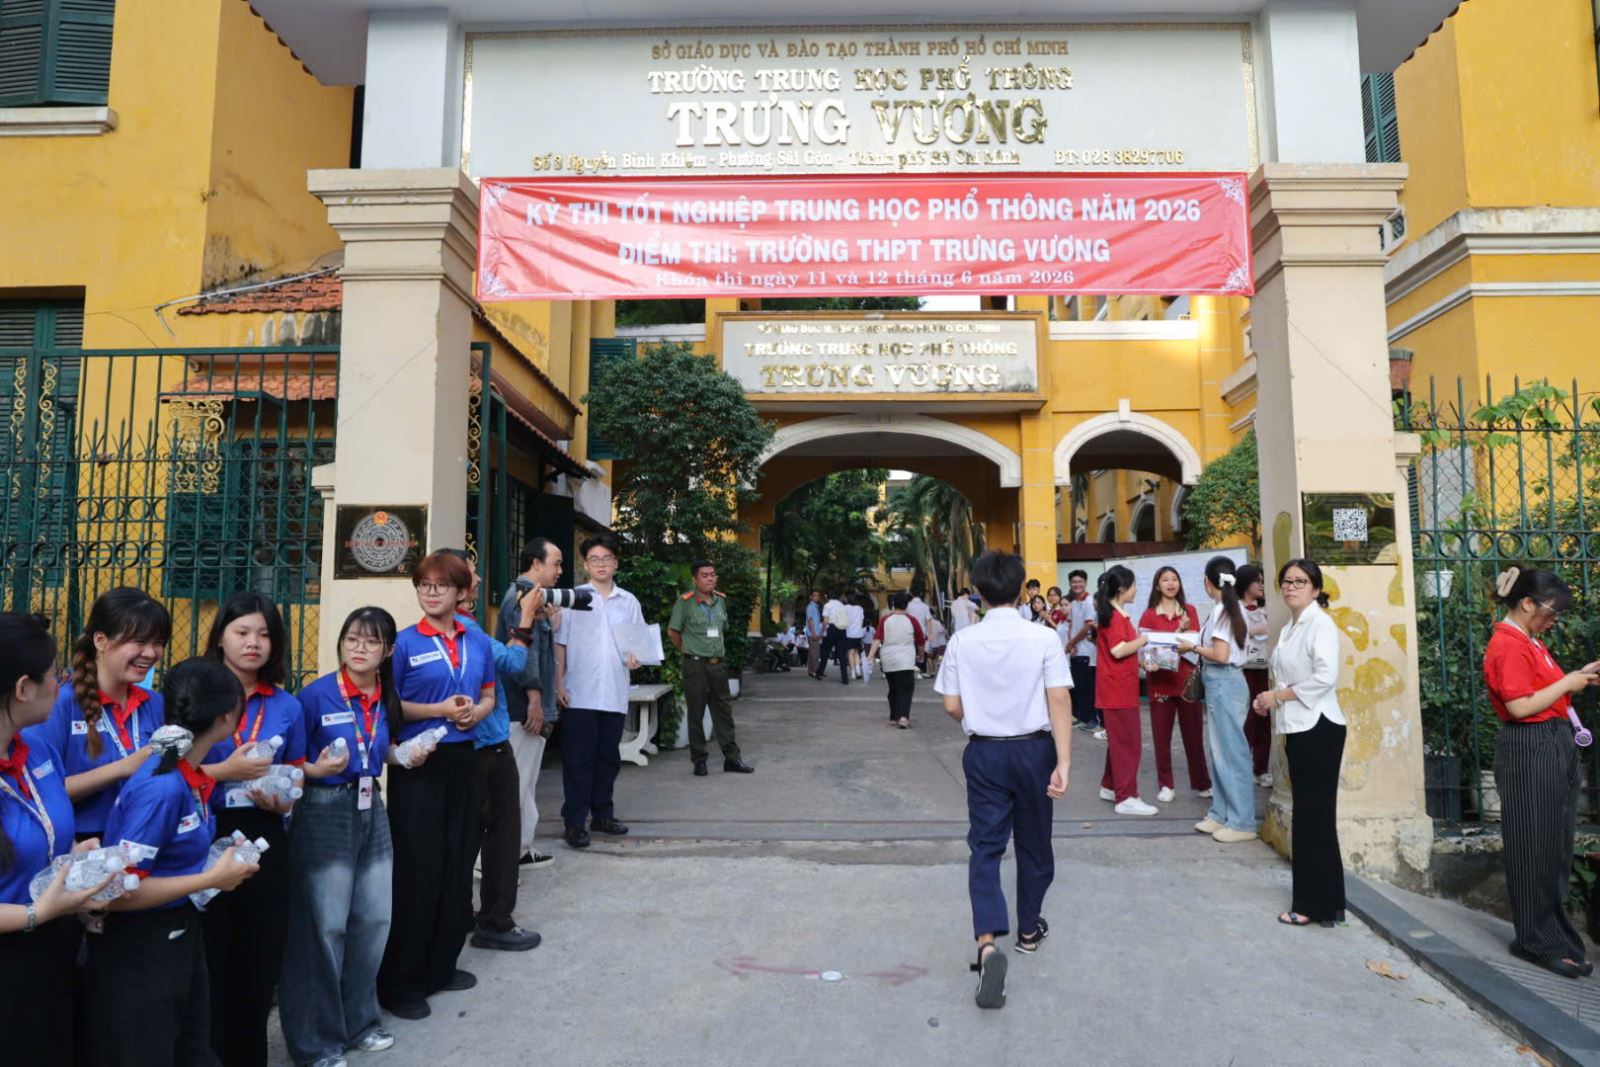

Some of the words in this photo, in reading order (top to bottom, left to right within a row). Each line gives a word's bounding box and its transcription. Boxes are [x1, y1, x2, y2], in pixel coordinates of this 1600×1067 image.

[651, 40, 671, 60] SỞ
[675, 40, 714, 59] GIÁO
[719, 43, 750, 62] DỤC
[757, 40, 779, 58] VÀ
[787, 38, 819, 58] ĐÀO
[826, 42, 858, 61] TẠO
[864, 38, 921, 56] THÀNH
[927, 37, 959, 56] PHỐ
[965, 34, 986, 55] HỒ
[993, 36, 1021, 55] CHÍ
[1027, 40, 1068, 55] MINH
[647, 64, 746, 94] TRƯỜNG
[754, 68, 842, 92] TRUNG
[854, 67, 908, 97] HỌC
[919, 55, 972, 91] PHỔ
[985, 62, 1073, 91] THÔNG
[667, 93, 851, 147] TRƯNG
[871, 91, 1048, 146] VƯƠNG
[1082, 150, 1110, 165] 028
[1113, 149, 1185, 165] 38297706
[569, 202, 609, 225] THI
[616, 192, 664, 224] TỐT
[672, 195, 768, 229] NGHIỆP
[775, 198, 860, 222] TRUNG
[869, 197, 920, 228] HỌC
[927, 187, 979, 221] PHỔ
[987, 192, 1073, 221] THÔNG
[1082, 193, 1136, 222] NĂM
[1144, 198, 1200, 222] 2026
[618, 230, 681, 265] ĐIỂM
[689, 240, 737, 264] THI:
[745, 233, 849, 263] TRƯỜNG
[857, 238, 921, 262] THPT
[930, 234, 1016, 262] TRƯNG
[1024, 234, 1110, 262] VƯƠNG
[715, 272, 743, 286] thi
[751, 272, 799, 288] ngày
[808, 271, 827, 285] 11
[835, 271, 859, 285] và
[869, 270, 888, 285] 12
[896, 270, 955, 287] tháng
[961, 270, 972, 285] 6
[980, 271, 1023, 285] năm
[1030, 270, 1075, 285] 2026
[817, 342, 874, 356] TRUNG
[961, 340, 1018, 356] THÔNG
[760, 361, 875, 388] TRƯNG
[885, 361, 1001, 387] VƯƠNG
